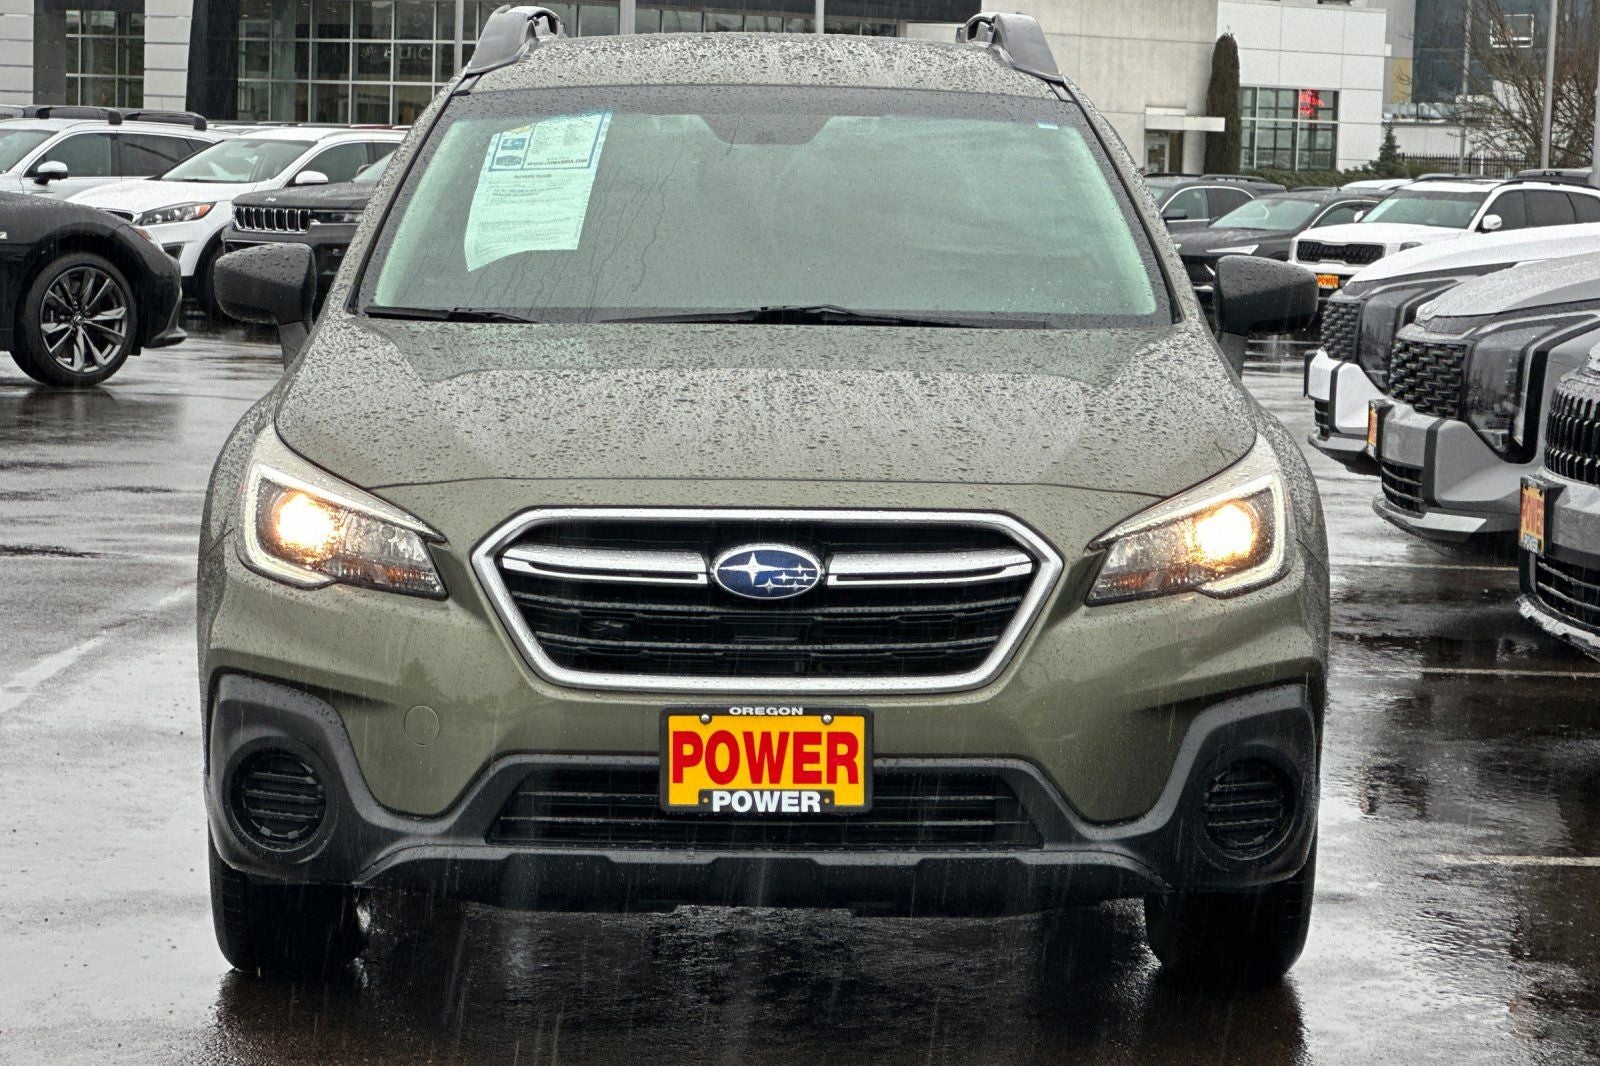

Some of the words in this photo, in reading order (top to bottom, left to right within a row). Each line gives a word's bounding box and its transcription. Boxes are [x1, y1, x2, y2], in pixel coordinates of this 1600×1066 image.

[728, 706, 804, 716] OREGON
[672, 729, 859, 786] POWER
[712, 789, 821, 813] POWER
